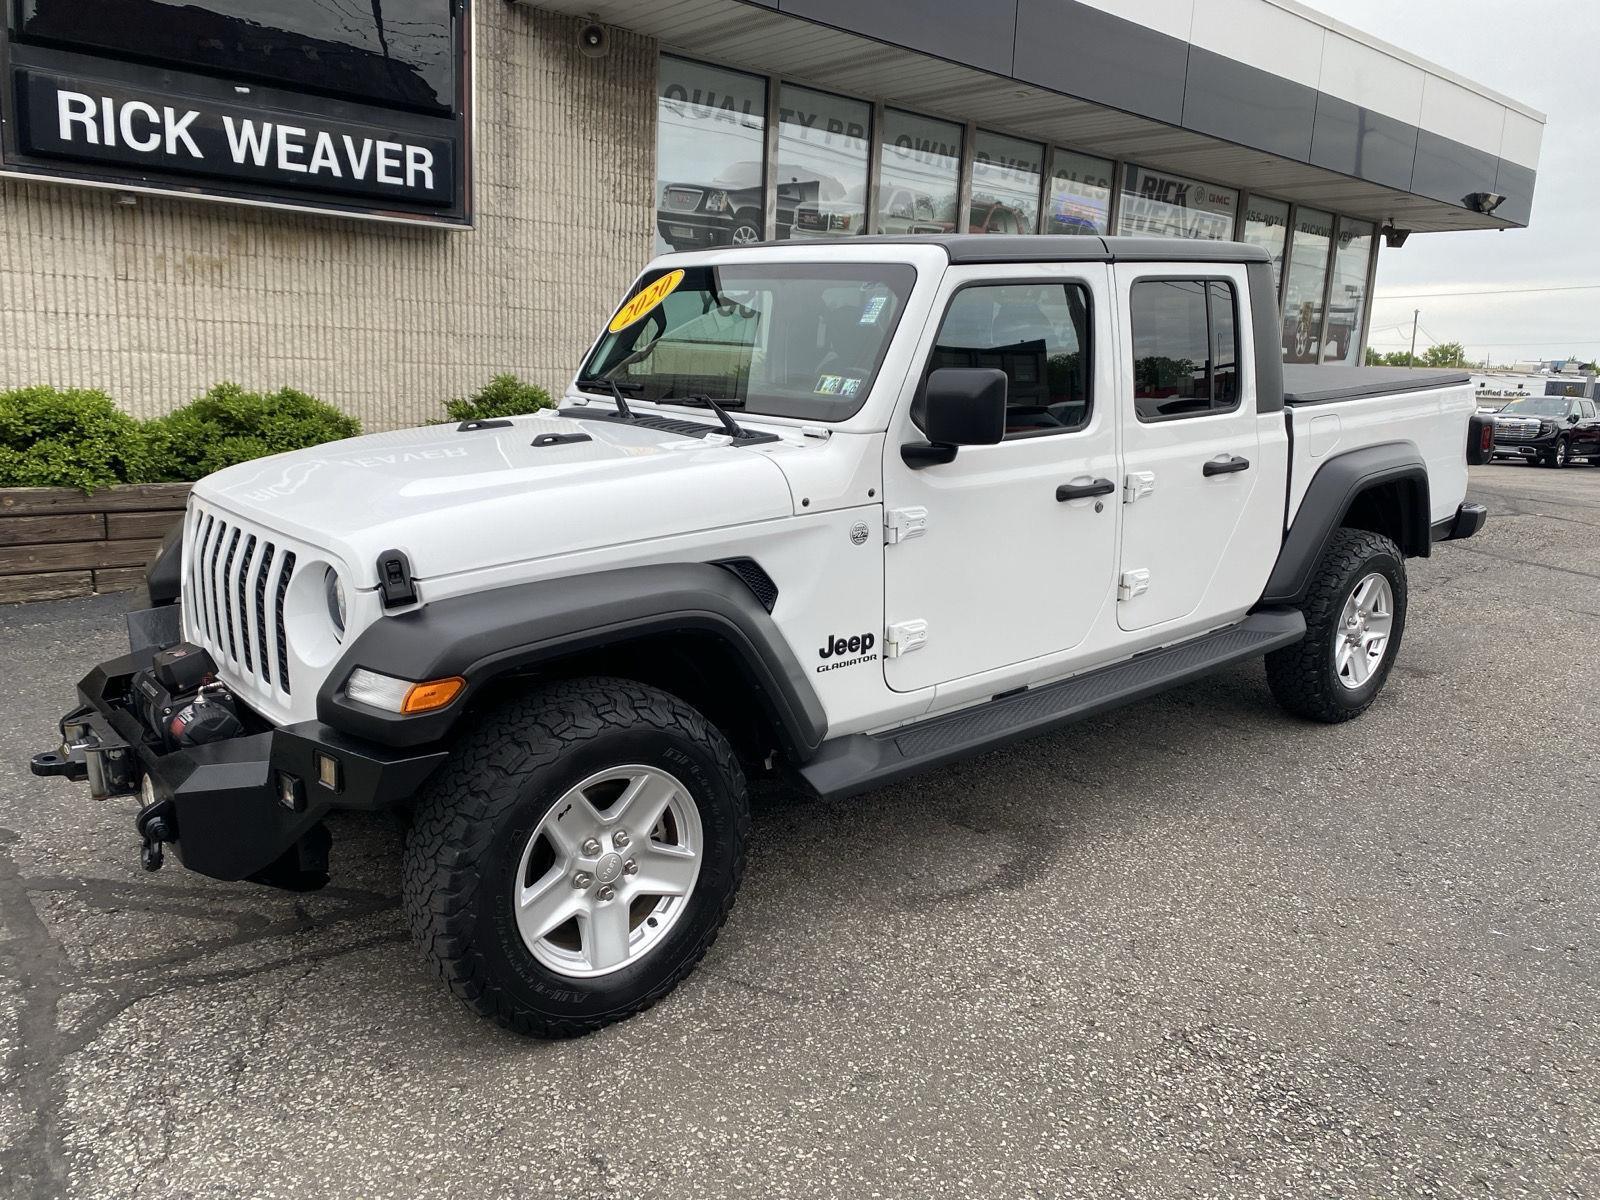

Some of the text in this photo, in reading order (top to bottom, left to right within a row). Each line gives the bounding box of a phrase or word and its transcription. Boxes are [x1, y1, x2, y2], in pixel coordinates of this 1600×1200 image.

[663, 83, 818, 140] QUALTY
[57, 89, 434, 189] RICK WEAVER
[1141, 175, 1230, 208] RICK GMC
[1121, 197, 1229, 240] WEAVER
[620, 275, 673, 326] 2020
[1475, 389, 1501, 397] ertified
[816, 654, 877, 673] GLADIATOR
[819, 633, 875, 659] Jeep
